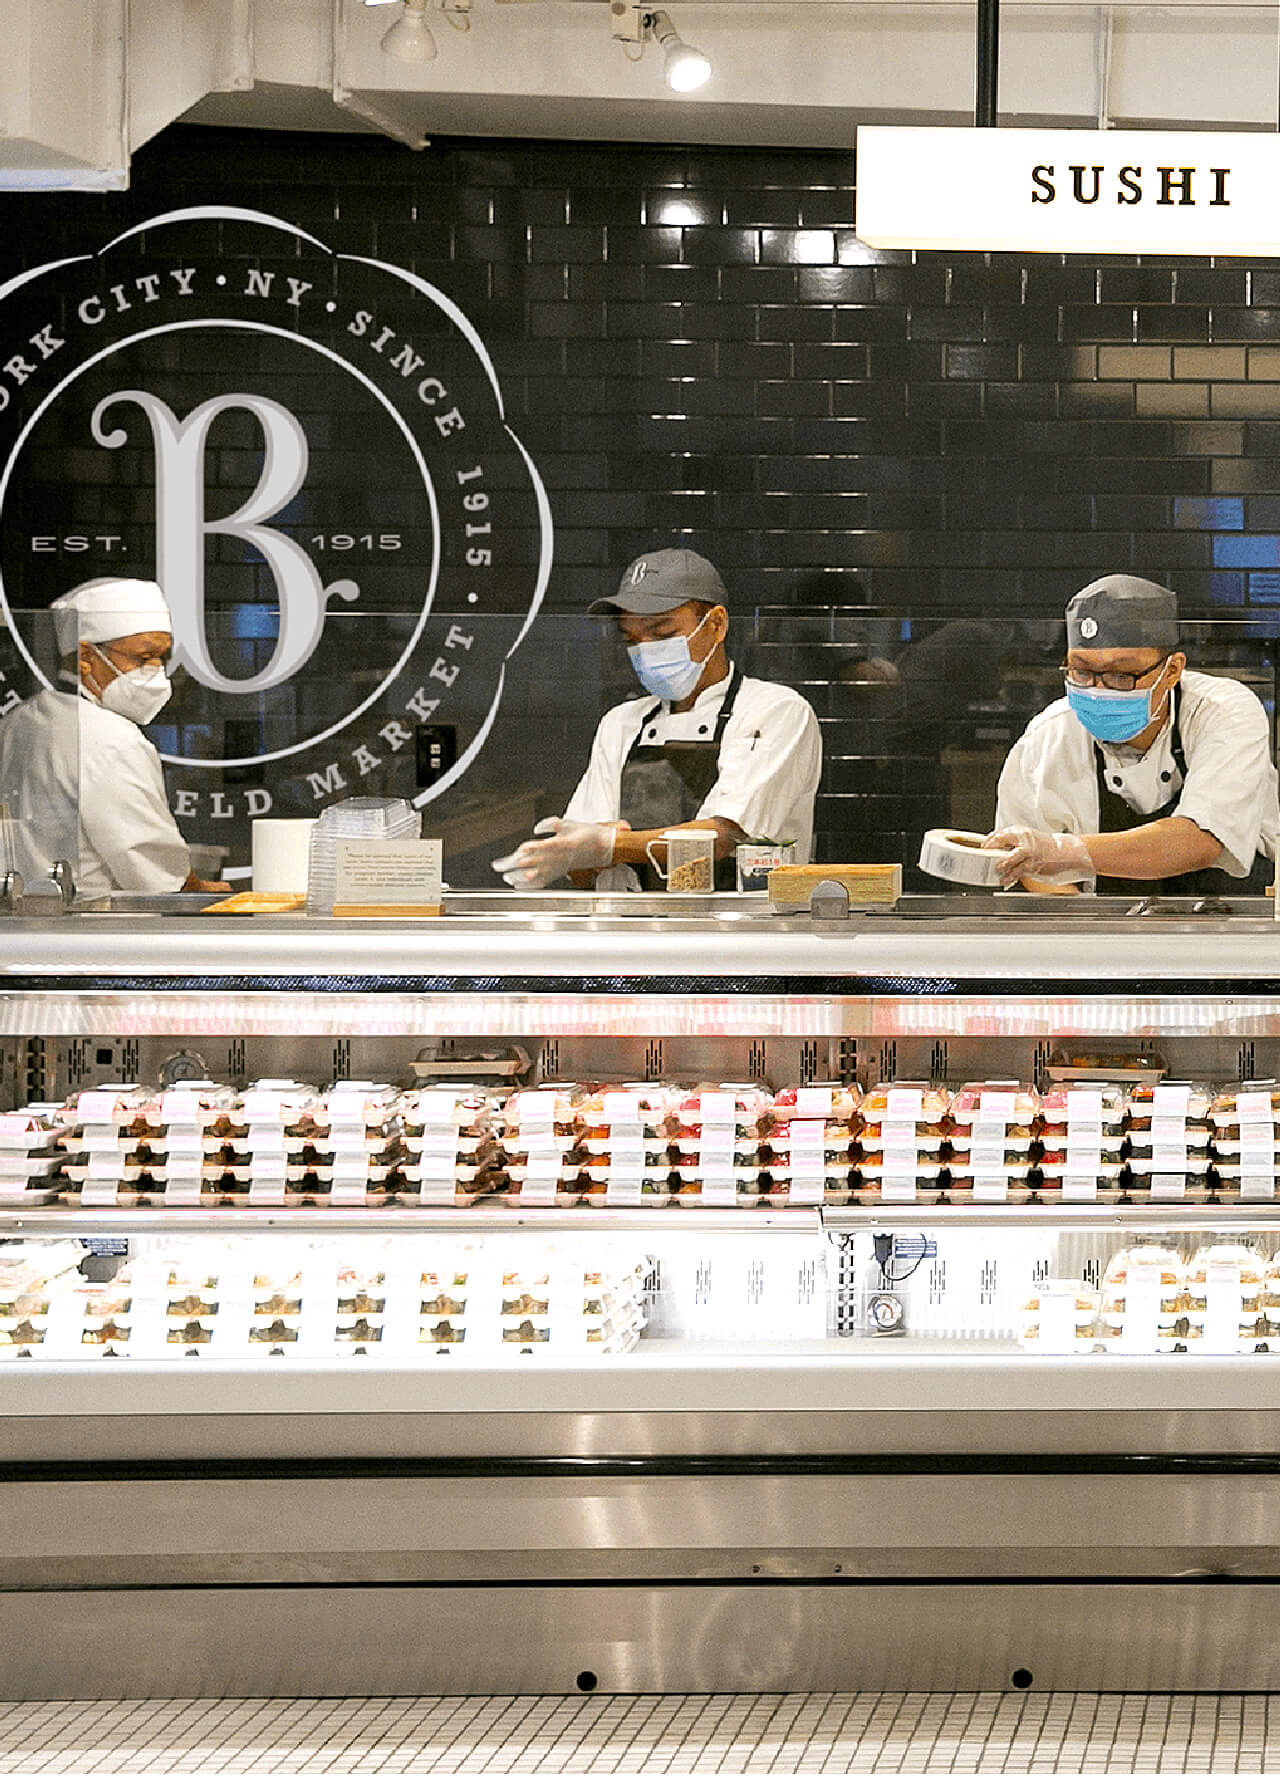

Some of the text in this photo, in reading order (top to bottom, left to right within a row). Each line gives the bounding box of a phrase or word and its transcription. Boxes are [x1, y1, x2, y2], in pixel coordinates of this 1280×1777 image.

[1031, 165, 1231, 206] SUSHI
[79, 269, 198, 325] CITY
[244, 269, 313, 306] NY
[347, 310, 465, 437] SINCE
[457, 465, 492, 567] 1915
[32, 534, 401, 551] EST. 1915
[306, 625, 474, 800] MARKET
